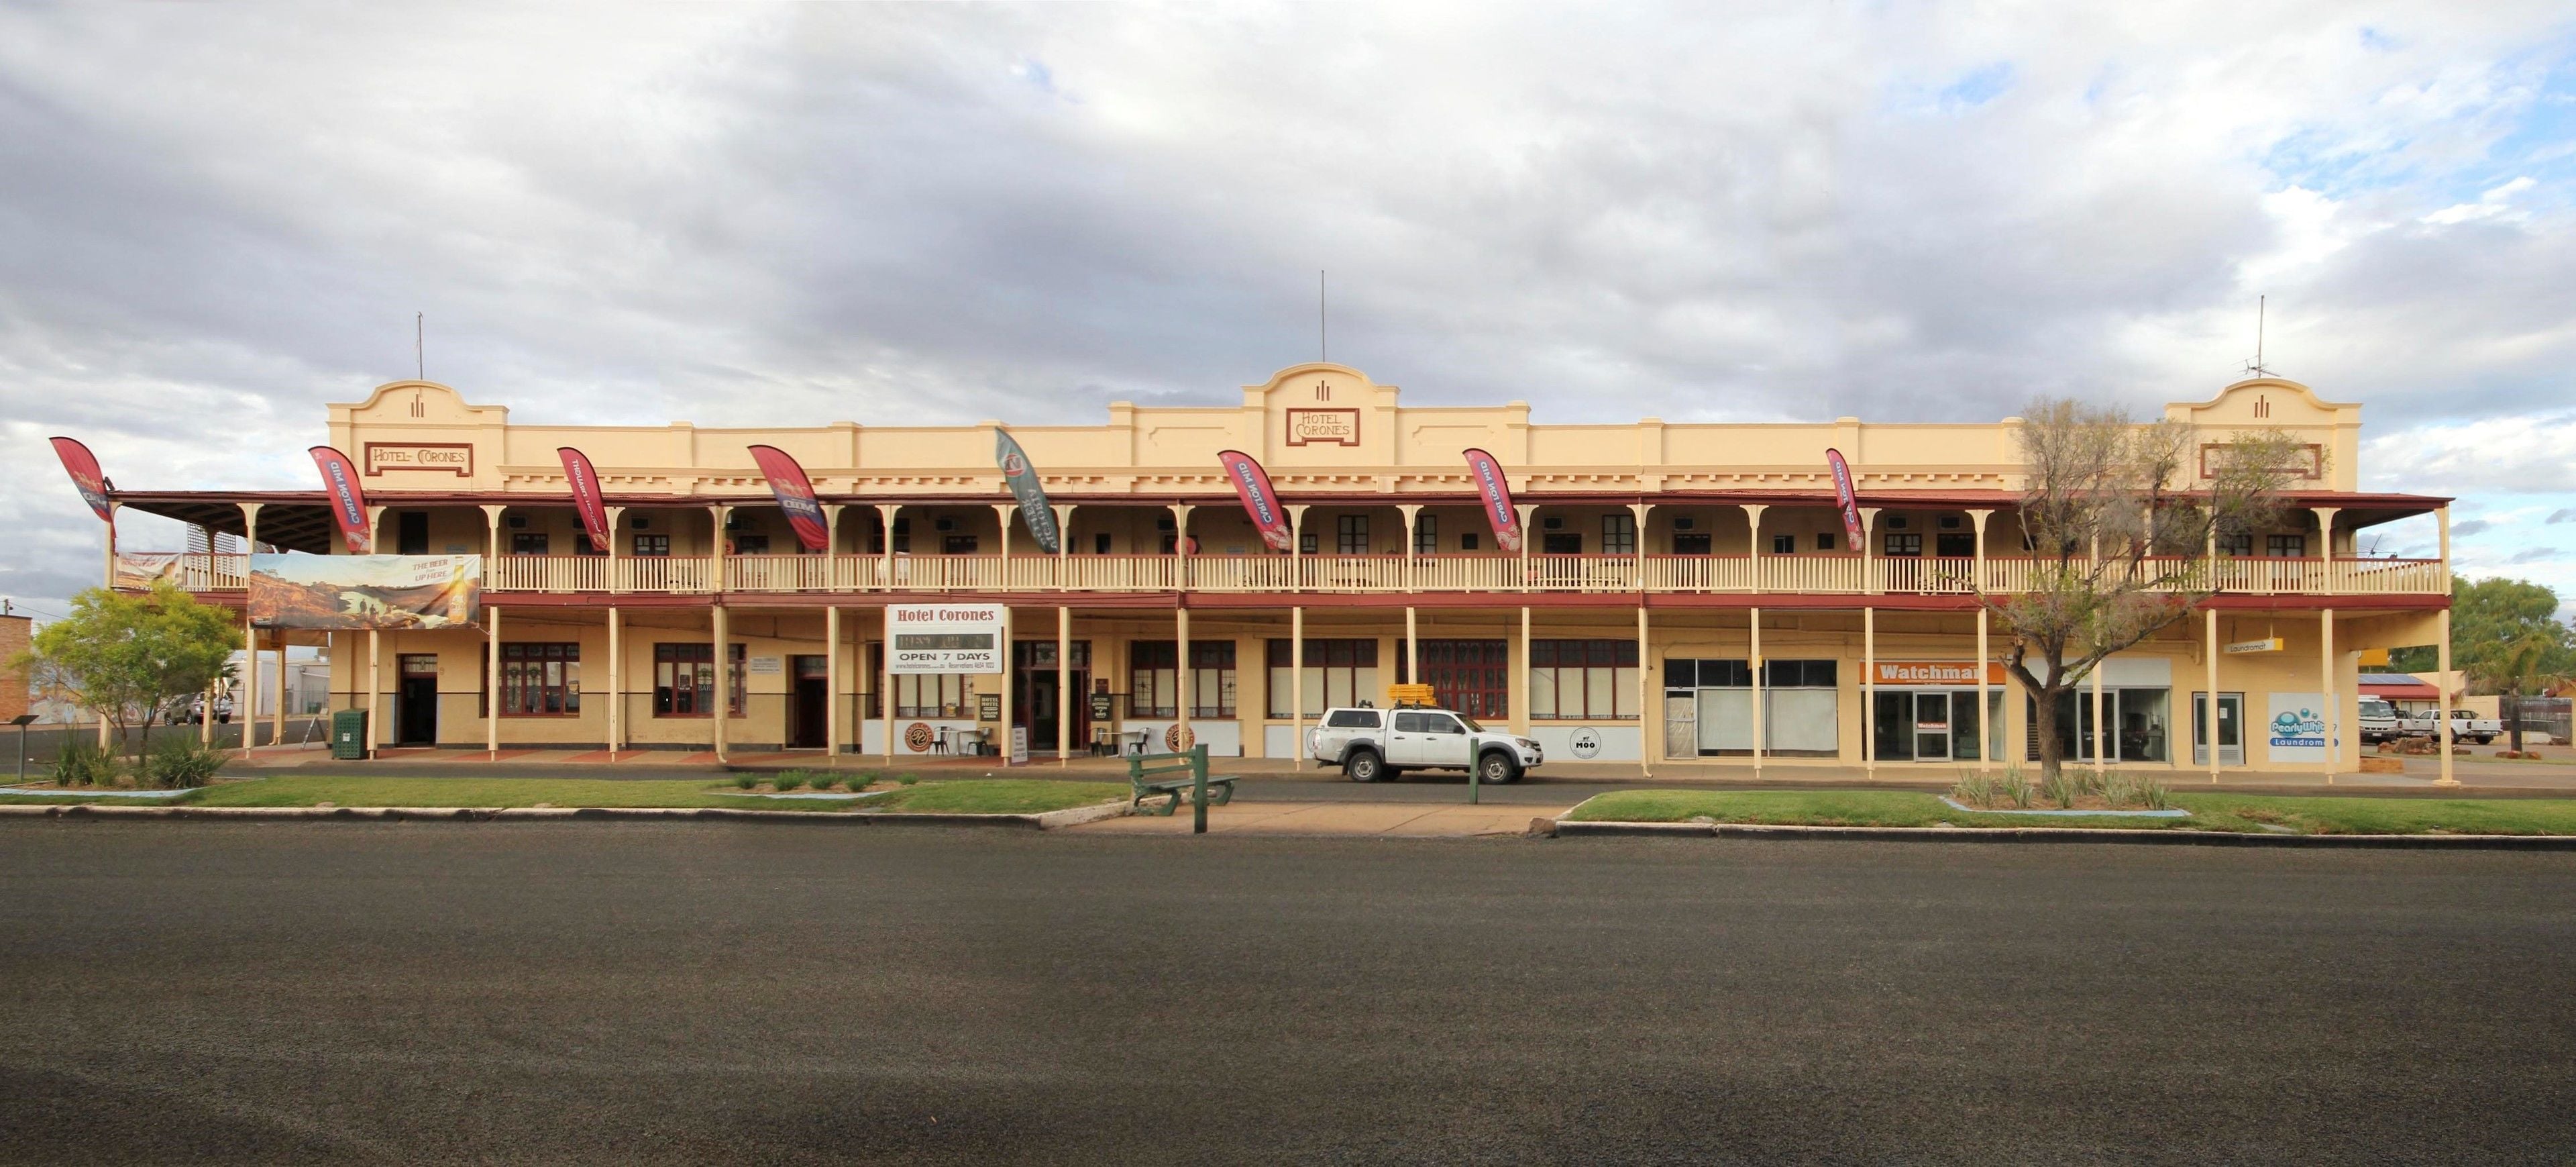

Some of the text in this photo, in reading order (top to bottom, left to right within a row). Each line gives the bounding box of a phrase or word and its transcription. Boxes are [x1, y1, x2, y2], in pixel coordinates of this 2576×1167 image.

[1302, 412, 1342, 424] HOTEL
[1296, 423, 1350, 438] CORONES
[417, 450, 465, 464] CORONES
[413, 559, 448, 570] THE BEER
[427, 570, 447, 580] HERE
[897, 609, 994, 621] Hotel Corones
[2231, 642, 2266, 652] Laundromat
[2271, 721, 2337, 735] PearlyWhit
